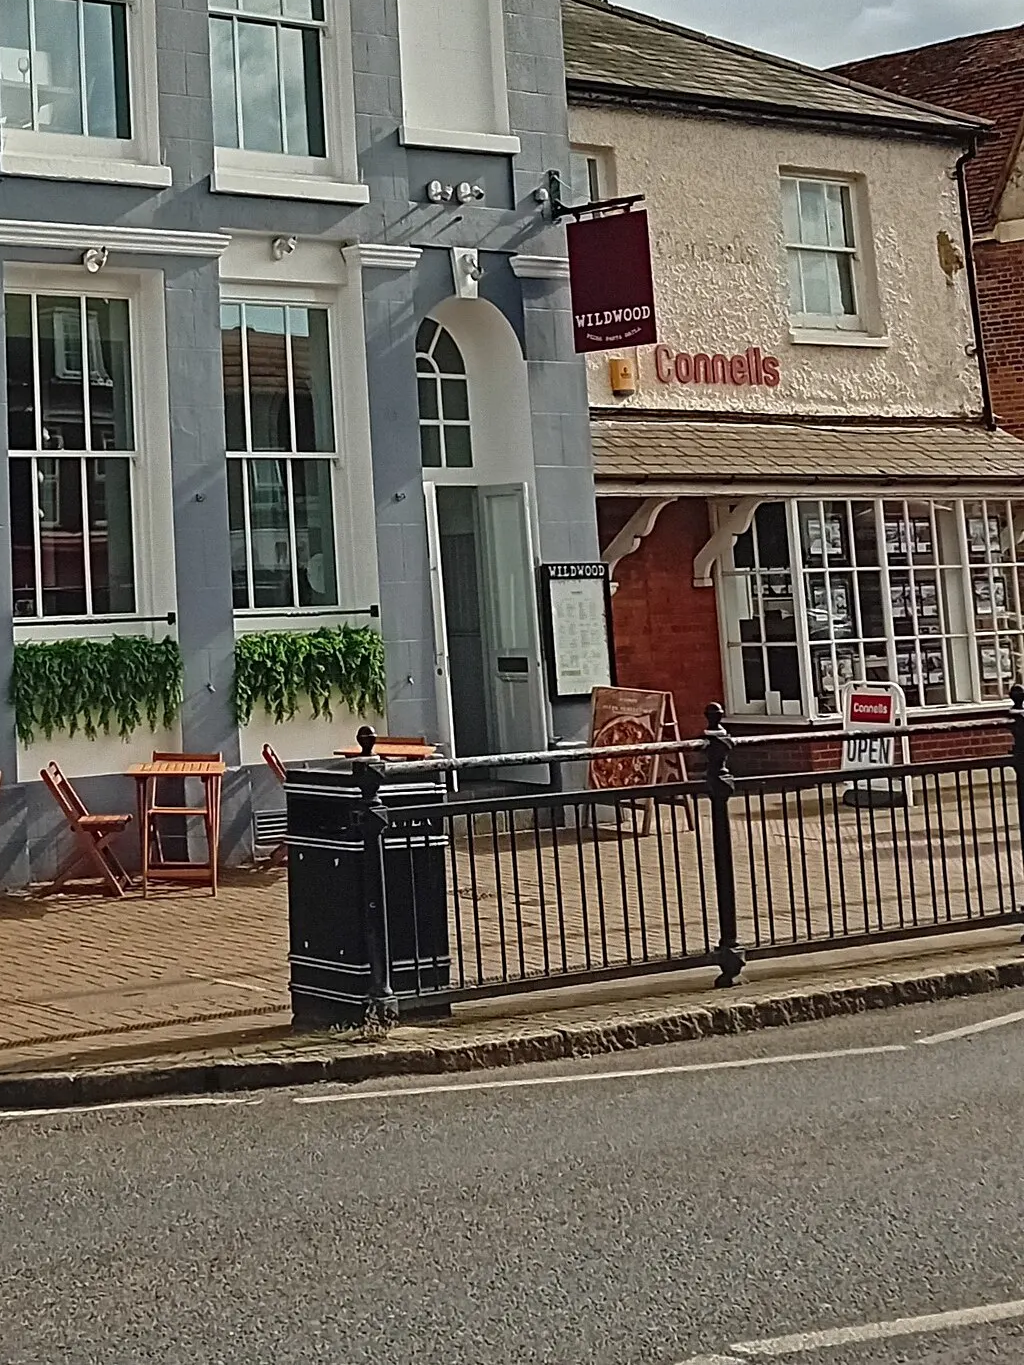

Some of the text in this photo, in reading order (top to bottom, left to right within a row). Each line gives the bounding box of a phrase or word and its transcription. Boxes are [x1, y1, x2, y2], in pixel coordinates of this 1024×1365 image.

[575, 305, 651, 328] WILDWOOD
[655, 344, 781, 387] Connells
[548, 565, 605, 577] WILDWOOD
[853, 702, 888, 715] Connells
[847, 736, 891, 764] OPEN
